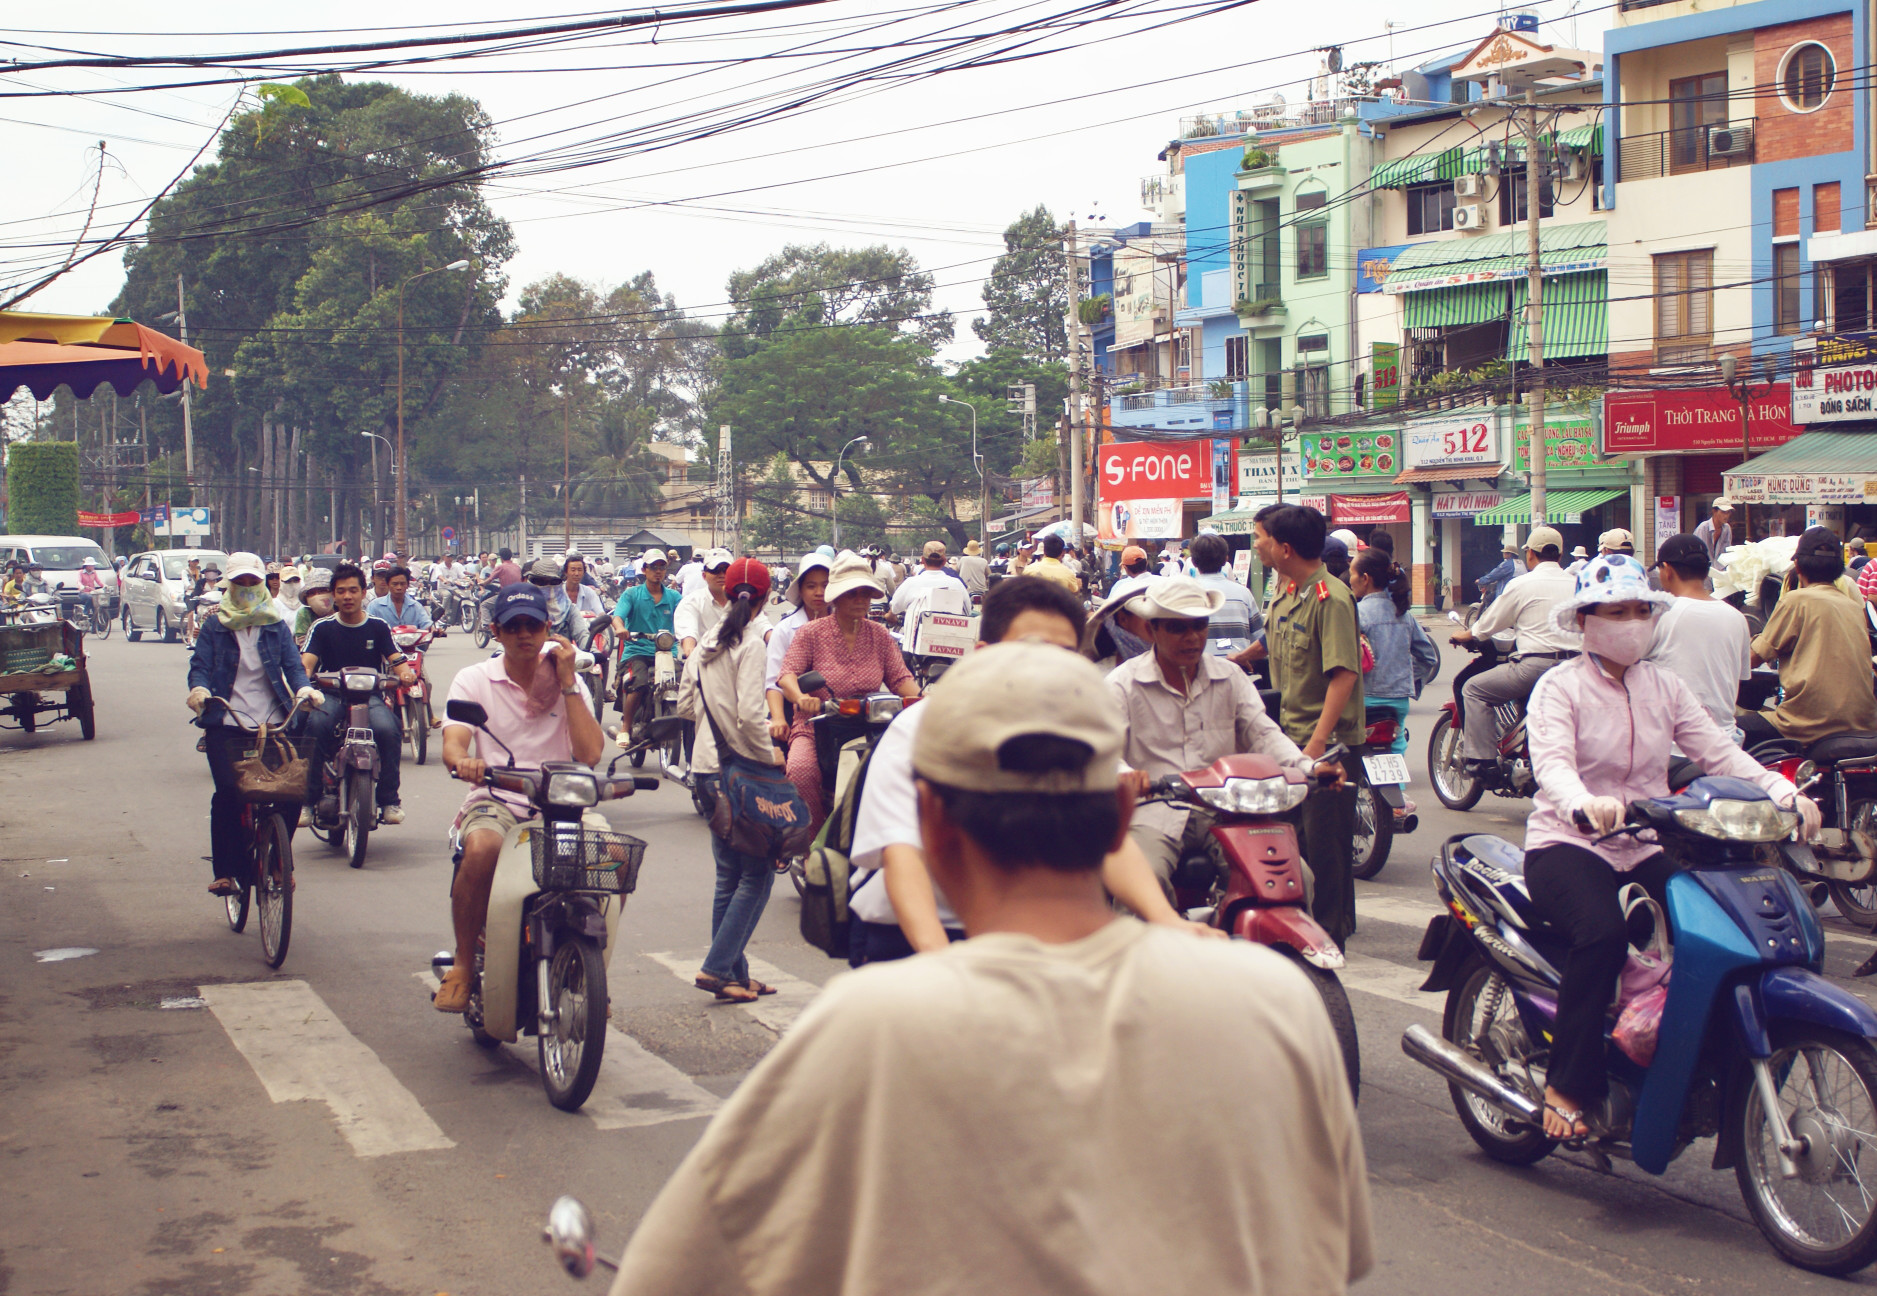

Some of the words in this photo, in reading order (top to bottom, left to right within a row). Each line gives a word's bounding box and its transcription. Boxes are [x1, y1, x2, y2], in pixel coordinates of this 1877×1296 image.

[1374, 365, 1398, 390] 512
[1824, 369, 1877, 395] PHOTO
[1664, 406, 1693, 425] THỜI
[1695, 408, 1736, 424] TRANG
[1759, 404, 1787, 421] HƠN
[1614, 421, 1651, 436] Triumph
[1444, 423, 1489, 455] 512
[1475, 494, 1500, 508] NHAU
[935, 616, 966, 626] RAYNAL
[931, 646, 961, 655] RAYNAL
[1375, 769, 1404, 782] 4739
